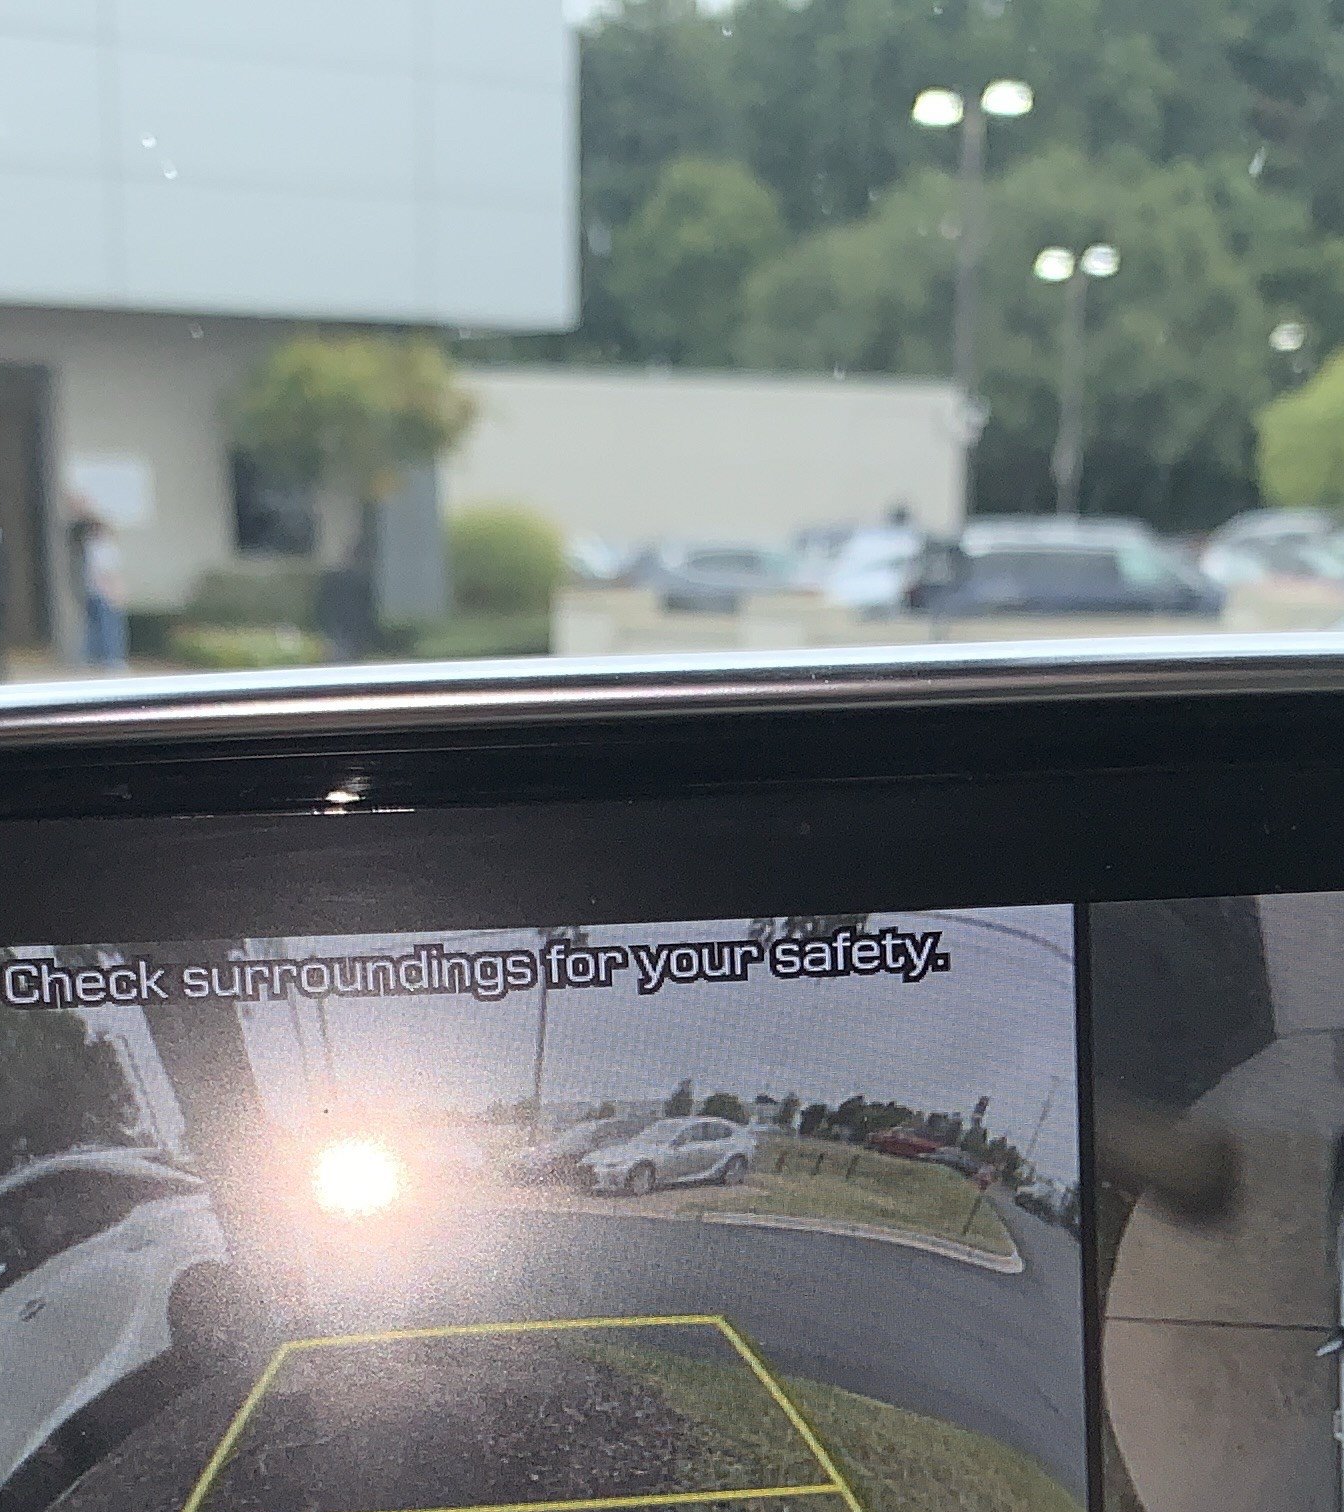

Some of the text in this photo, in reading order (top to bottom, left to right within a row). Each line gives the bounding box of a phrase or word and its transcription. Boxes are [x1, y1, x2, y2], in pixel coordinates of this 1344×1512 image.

[3, 930, 949, 1006] Check surroundings for your safety.
